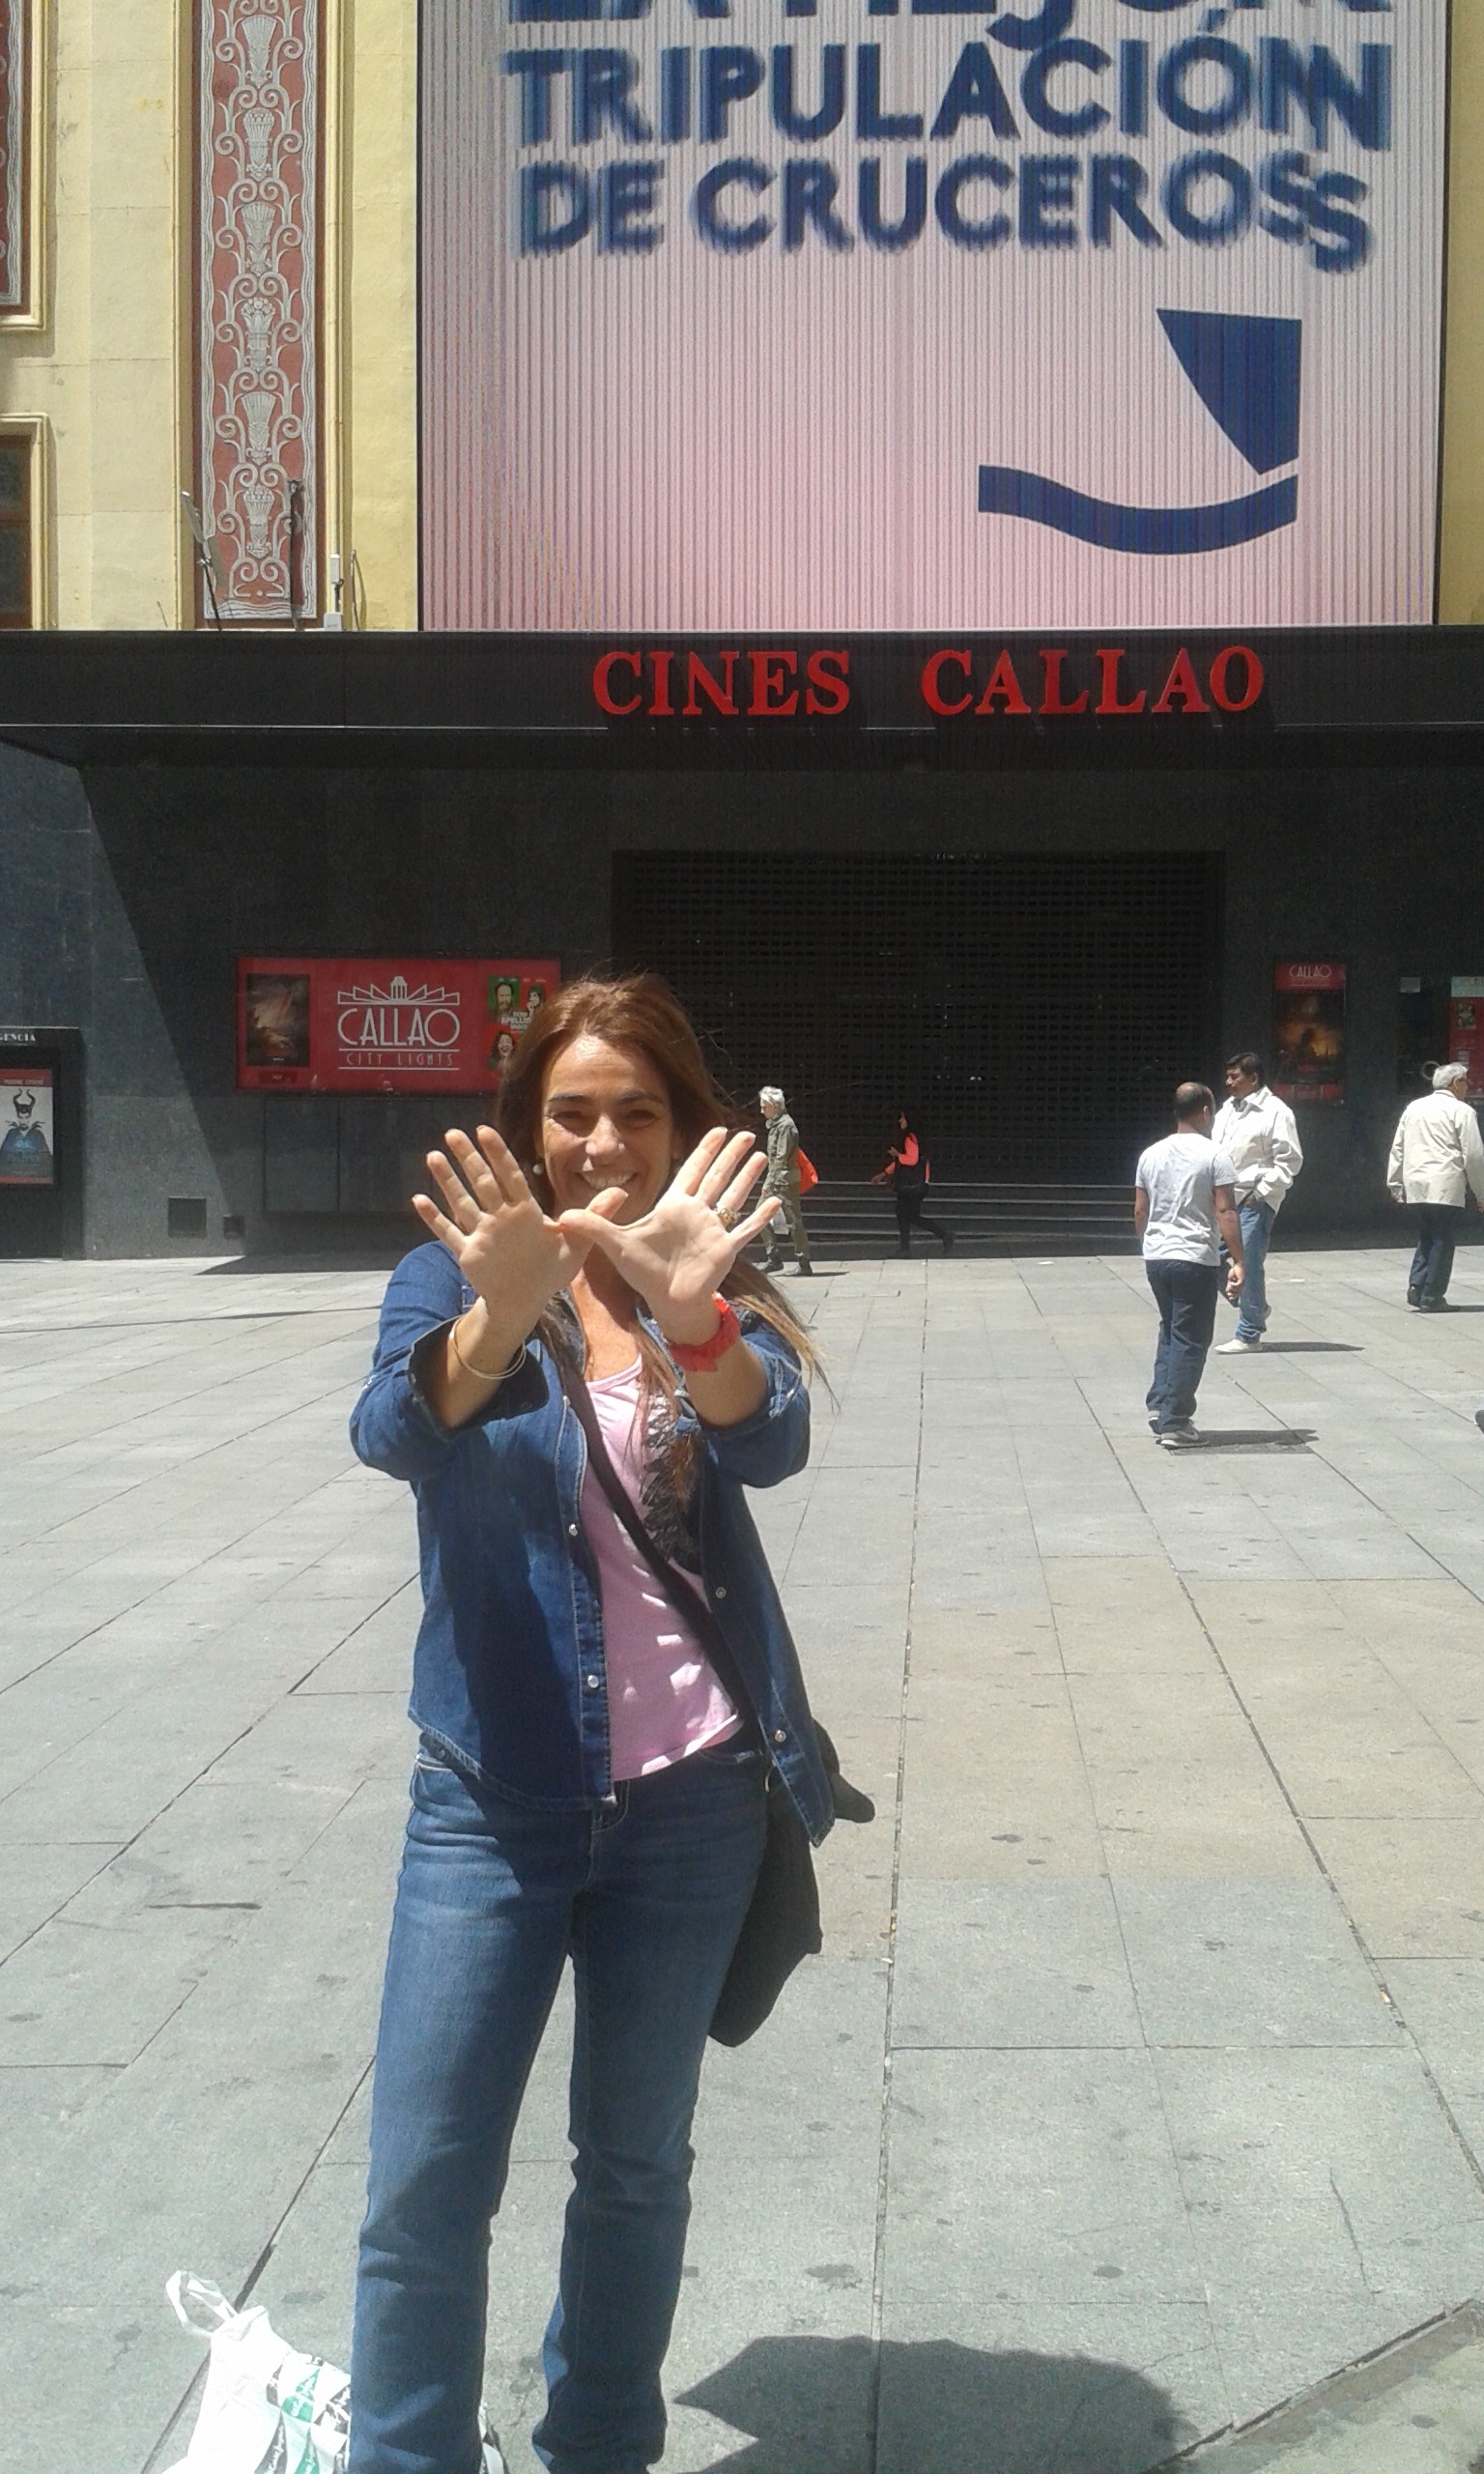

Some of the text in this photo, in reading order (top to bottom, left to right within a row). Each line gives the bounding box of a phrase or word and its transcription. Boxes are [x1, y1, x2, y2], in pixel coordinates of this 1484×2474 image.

[516, 158, 665, 258] DE
[592, 645, 1264, 716] CINES CALLAO
[338, 1008, 461, 1047] CALLAO
[346, 1052, 453, 1066] CITY LIGHTS
